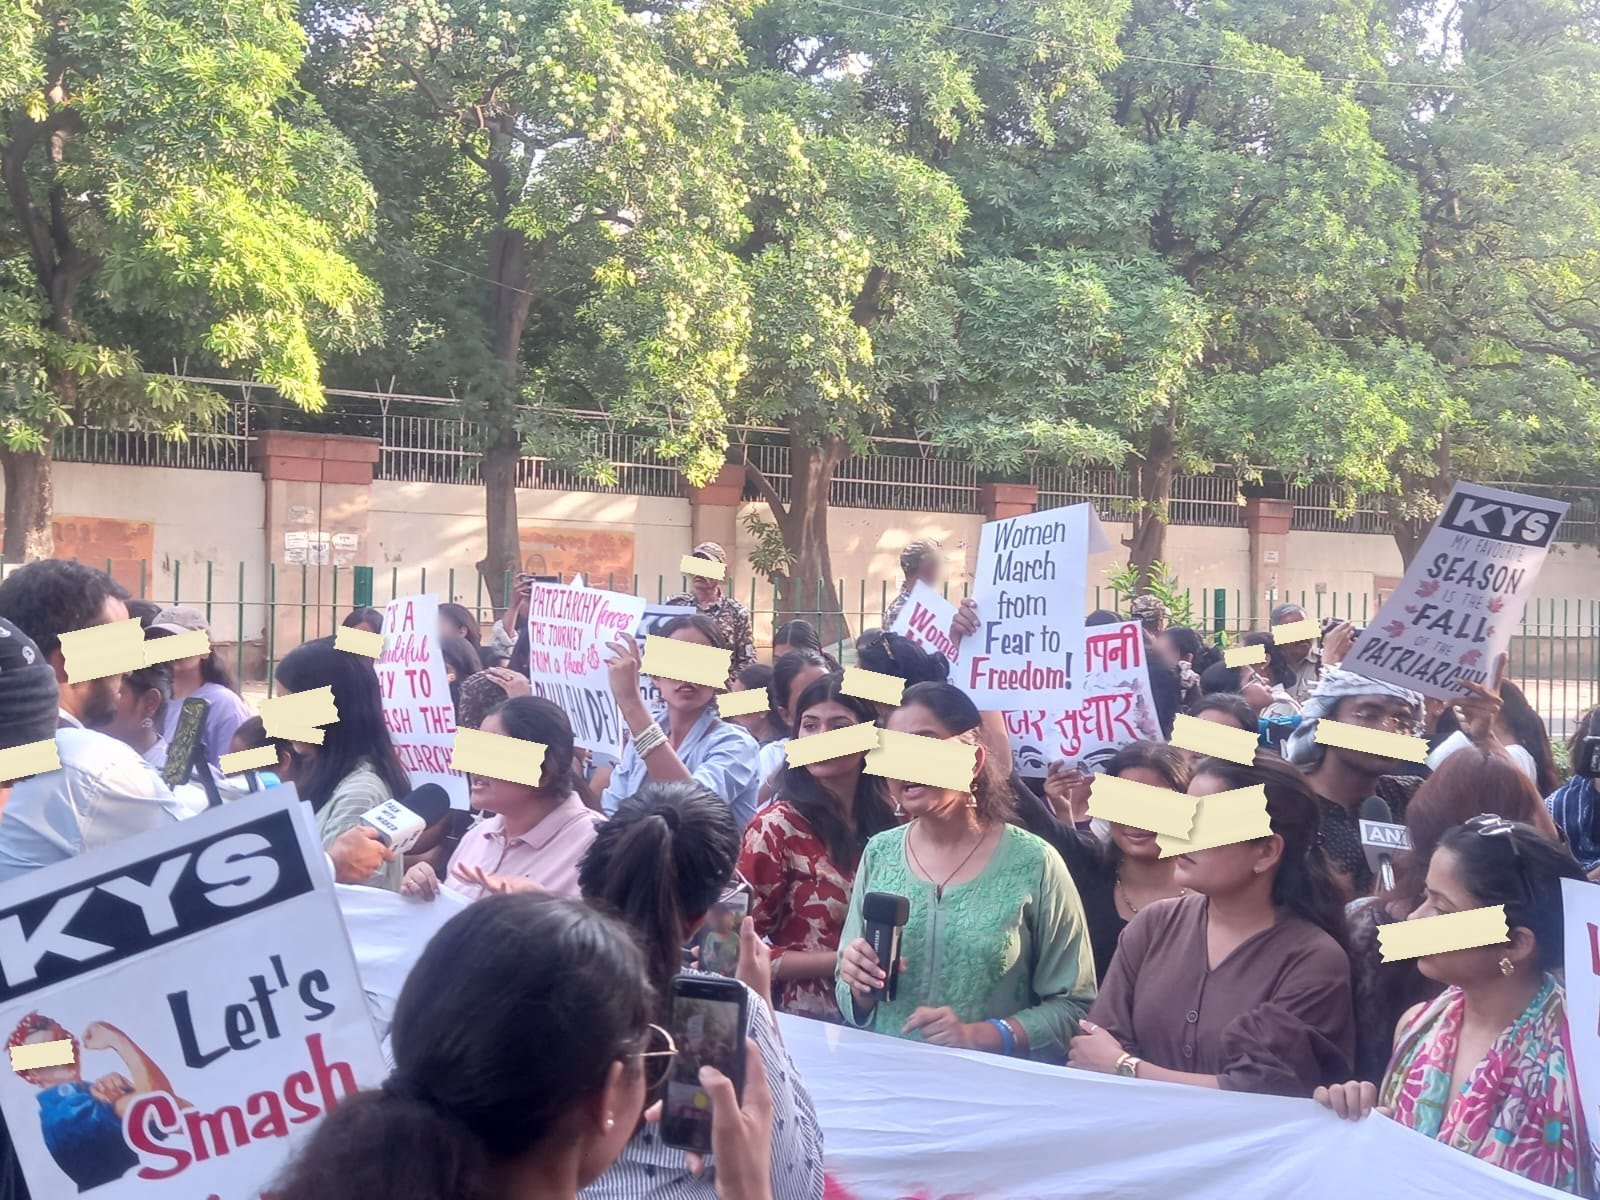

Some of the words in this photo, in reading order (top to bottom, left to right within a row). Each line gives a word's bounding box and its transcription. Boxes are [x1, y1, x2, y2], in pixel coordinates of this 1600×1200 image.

[994, 519, 1065, 552] Women
[1453, 498, 1549, 541] KYS
[1451, 535, 1471, 551] MY
[993, 551, 1056, 585] March
[1427, 553, 1525, 594] SEASON
[531, 586, 602, 624] PATRIARCHY
[595, 600, 634, 639] forces
[997, 591, 1047, 620] from
[1442, 588, 1456, 604] IS
[1462, 592, 1483, 610] THE
[403, 601, 414, 632] A
[1412, 604, 1488, 644] FALL
[531, 621, 546, 645] THE
[550, 624, 583, 651] JOURNEY
[985, 621, 1034, 655] Fear
[1041, 625, 1060, 653] to
[1414, 636, 1430, 646] OF
[1434, 640, 1454, 656] THE
[379, 671, 394, 698] AY
[405, 669, 432, 698] TO
[969, 652, 1073, 690] Freedom!
[384, 708, 412, 733] ASH
[420, 706, 457, 733] THE
[0, 833, 280, 986] KYS
[167, 955, 336, 1069] Let's
[127, 1033, 361, 1180] Smash
